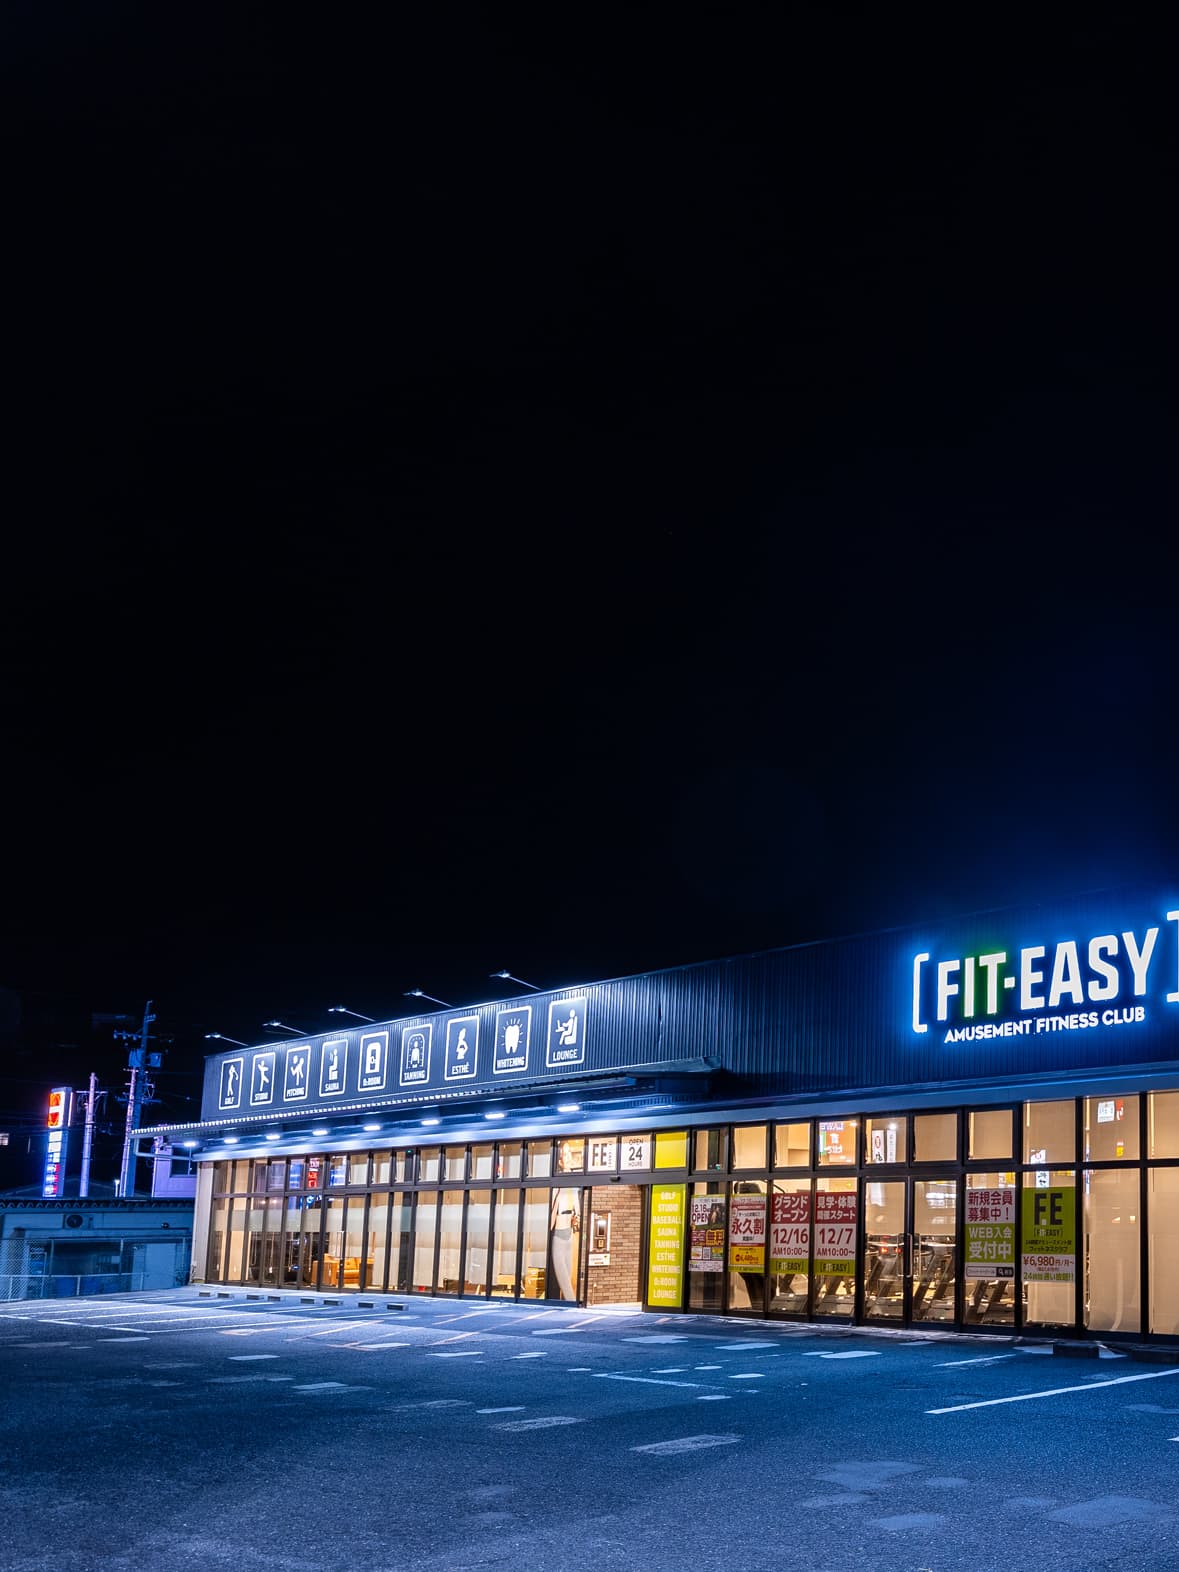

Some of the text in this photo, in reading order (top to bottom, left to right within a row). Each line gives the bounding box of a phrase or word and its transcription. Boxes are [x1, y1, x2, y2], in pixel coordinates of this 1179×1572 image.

[944, 1007, 1145, 1043] AMUSEMENT FITNESS CLUB
[552, 1049, 578, 1062] LOUNGE
[496, 1056, 525, 1068] WHITENING
[404, 1070, 426, 1081] TANNING
[286, 1087, 305, 1097] PITCHING
[325, 1082, 340, 1092] SAUNA
[224, 1097, 235, 1105] GOLF
[628, 1138, 644, 1146] OPEN
[628, 1146, 643, 1161] 24
[660, 1191, 676, 1200] GOLF
[967, 1190, 1013, 1206] 新規会員
[774, 1195, 809, 1209] グランド
[817, 1195, 857, 1209] 見学・体験
[652, 1215, 681, 1225] BASEBALL
[691, 1212, 710, 1223] OPEN
[774, 1208, 809, 1222] オープン
[657, 1227, 677, 1237] SAUNA
[731, 1218, 765, 1235] 永久割
[968, 1226, 1012, 1239] WEB入会
[772, 1227, 809, 1245] 12/16
[819, 1227, 854, 1245] 12/7
[654, 1239, 680, 1249] TANNING
[968, 1240, 1012, 1260] 受付中
[651, 1264, 680, 1274] WHITENING
[653, 1289, 677, 1299] LOUNGE
